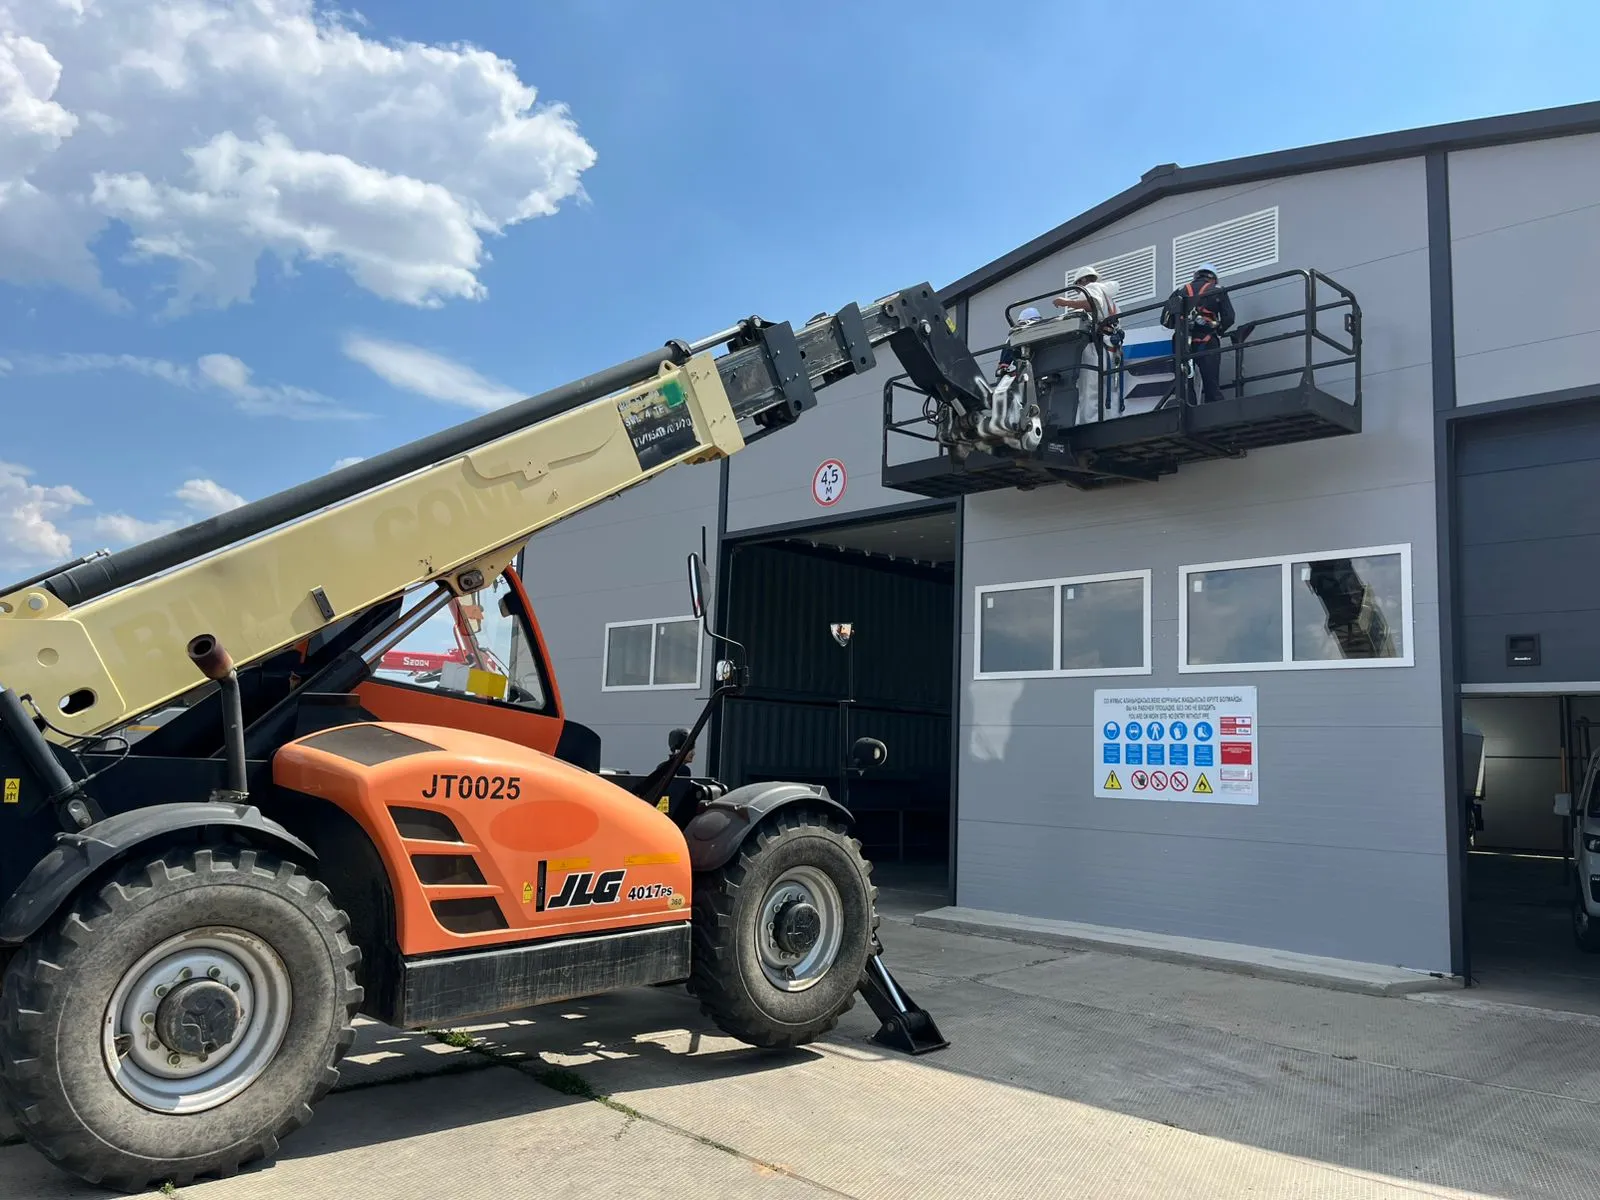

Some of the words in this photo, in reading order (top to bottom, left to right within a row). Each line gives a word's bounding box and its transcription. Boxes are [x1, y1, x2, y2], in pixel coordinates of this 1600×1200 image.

[821, 469, 839, 485] 4,5
[422, 774, 520, 800] JT0025
[546, 870, 626, 909] JLG
